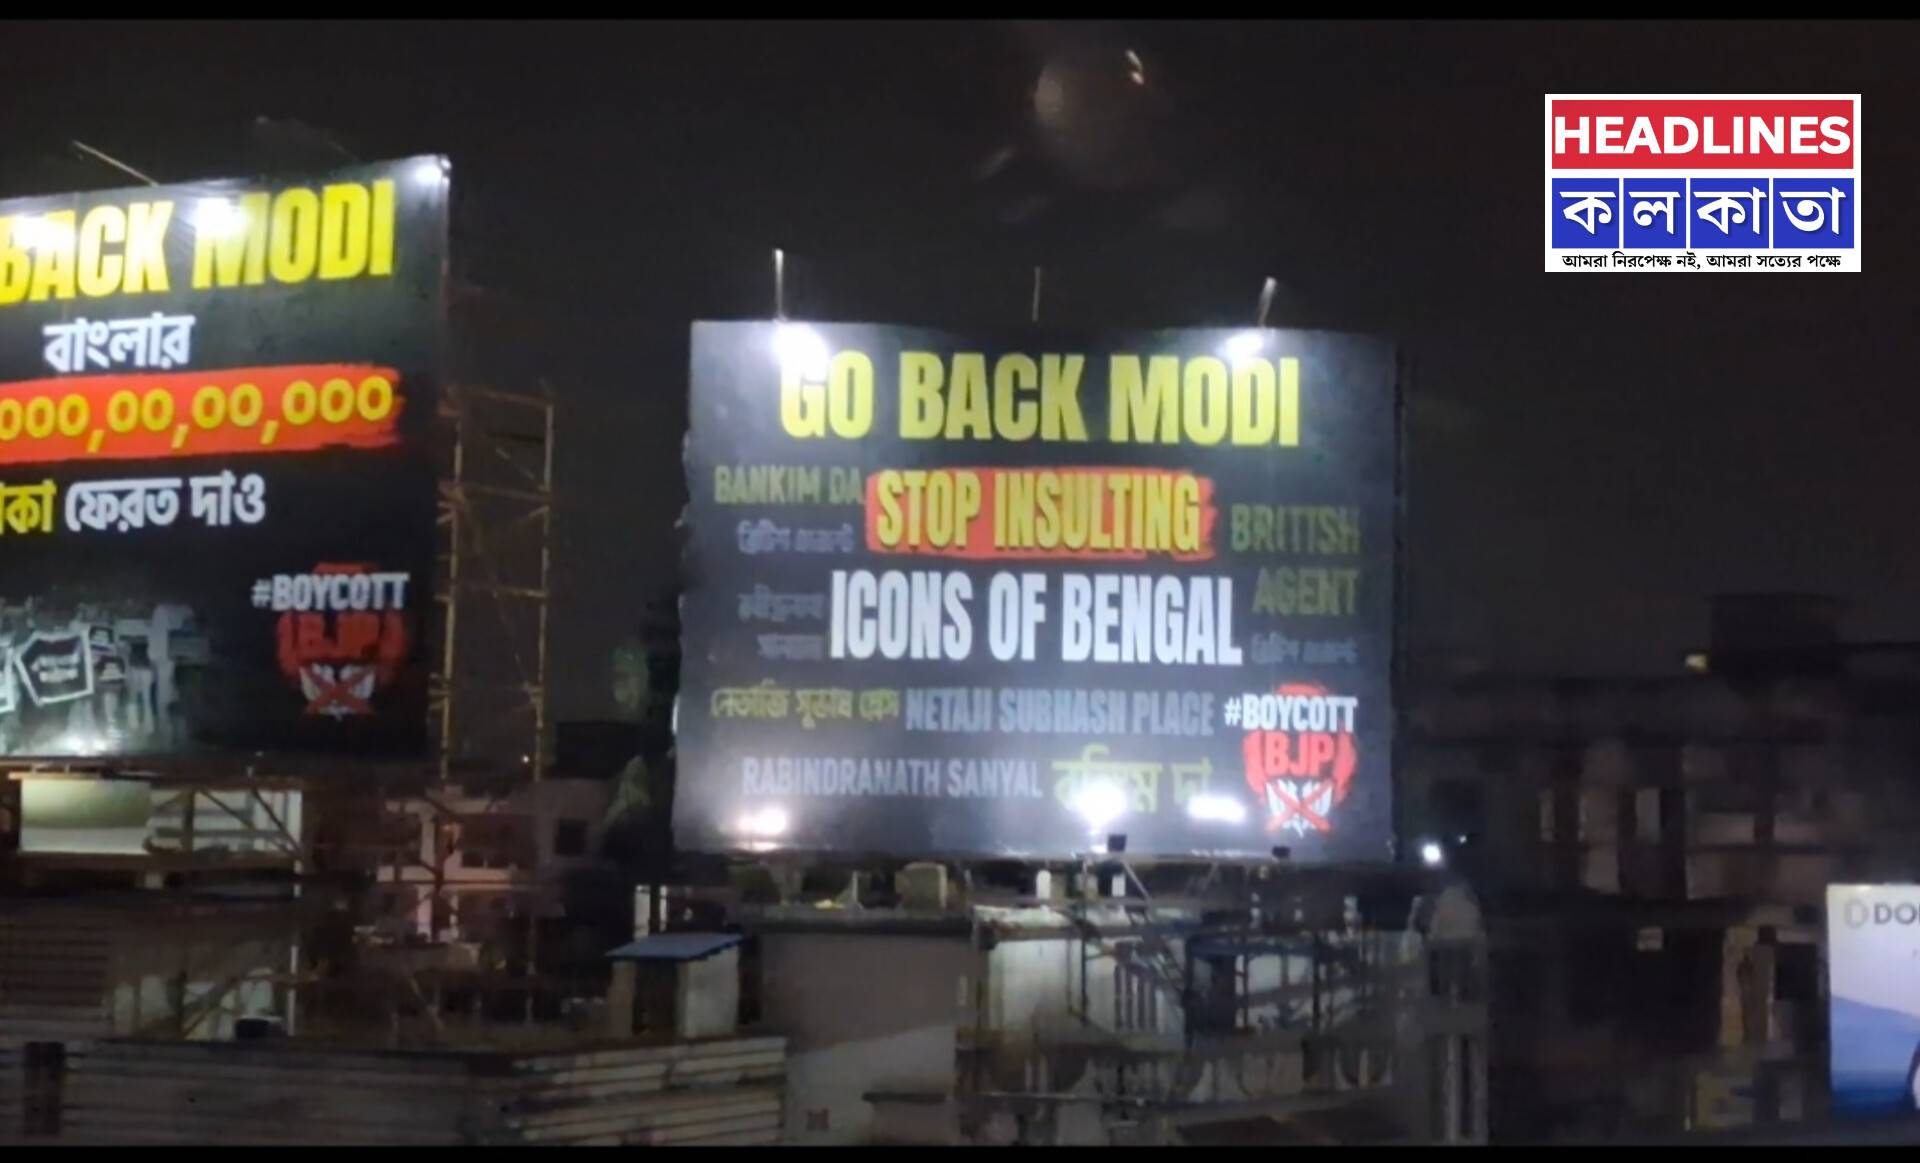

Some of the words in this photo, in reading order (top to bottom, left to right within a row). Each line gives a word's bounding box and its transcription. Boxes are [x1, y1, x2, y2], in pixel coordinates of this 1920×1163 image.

[0, 200, 174, 305] BACK
[192, 178, 395, 290] MODI
[43, 311, 196, 373] বাংলার
[780, 350, 874, 439] GO
[899, 351, 1089, 441] BACK
[1109, 353, 1299, 447] MODI
[65, 477, 183, 532] ফেরত
[190, 469, 266, 527] দাও
[714, 464, 821, 505] BANKIM
[876, 469, 982, 549] STOP
[993, 470, 1200, 553] INSULTING
[251, 572, 411, 612] #BOYCOTT
[1253, 565, 1360, 616] AGENT
[829, 569, 974, 660] ICONS
[988, 570, 1047, 661] OF
[1061, 573, 1243, 666] BENGAL
[905, 687, 993, 732] NETAJI
[999, 687, 1127, 734] SUBHASH
[1133, 690, 1215, 737] PLACE
[1224, 693, 1359, 733] #BOYCOTT
[741, 757, 940, 798] RABINDRANATH
[946, 758, 1044, 799] SANYAL
[1263, 730, 1335, 779] BJP
[1873, 902, 1920, 926] DO
